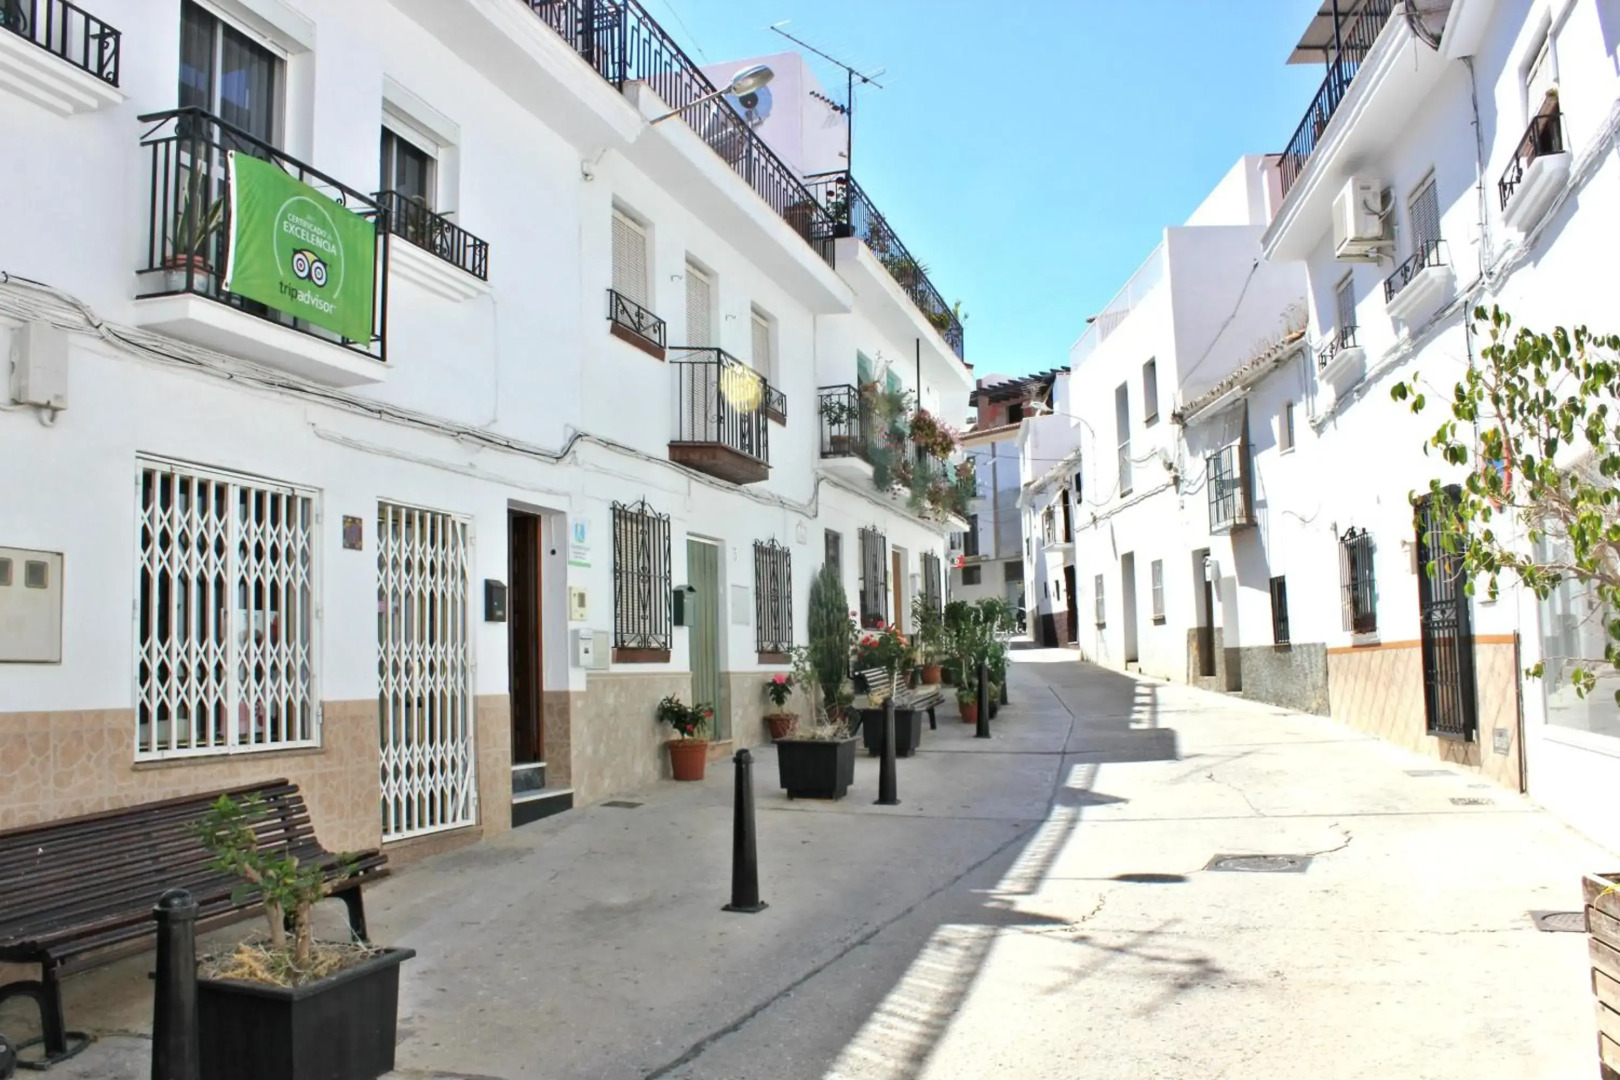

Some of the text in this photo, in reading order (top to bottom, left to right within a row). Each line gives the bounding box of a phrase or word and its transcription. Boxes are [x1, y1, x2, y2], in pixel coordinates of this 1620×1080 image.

[283, 220, 337, 256] EXCELENCIA
[287, 213, 327, 237] CERTIFICADO
[279, 281, 334, 314] tripadvisor
